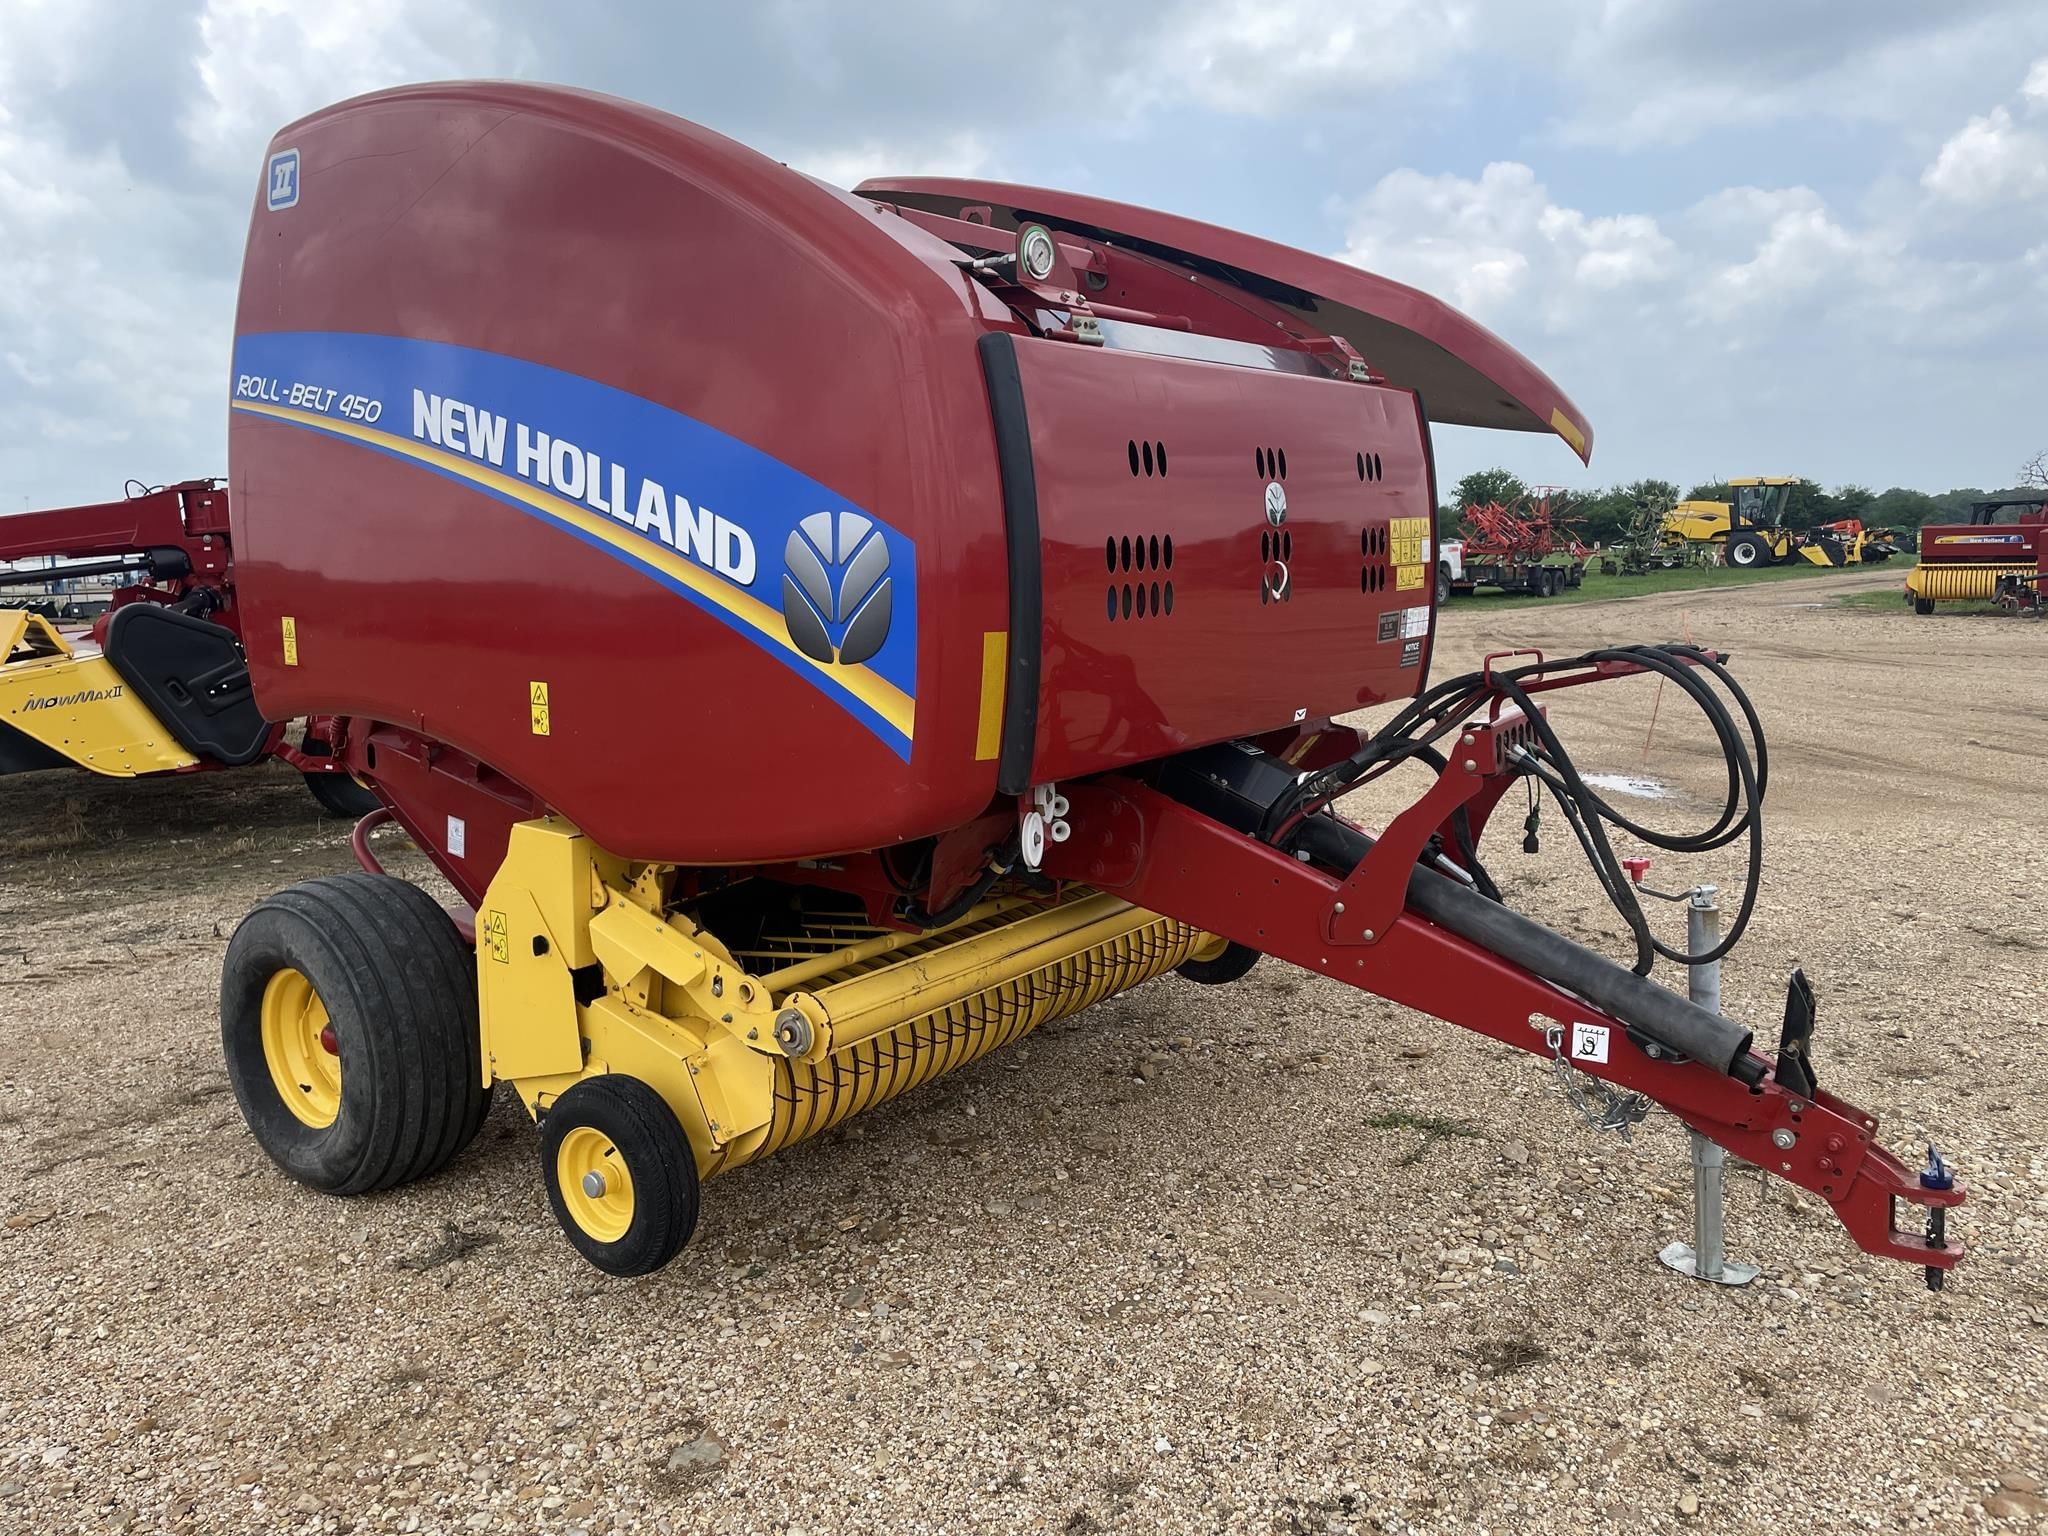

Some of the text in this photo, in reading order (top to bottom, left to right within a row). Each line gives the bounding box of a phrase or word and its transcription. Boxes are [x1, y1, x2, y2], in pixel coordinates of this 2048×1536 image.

[236, 374, 383, 423] ROLL-BELT 450
[413, 388, 757, 586] NEW HOLLAND
